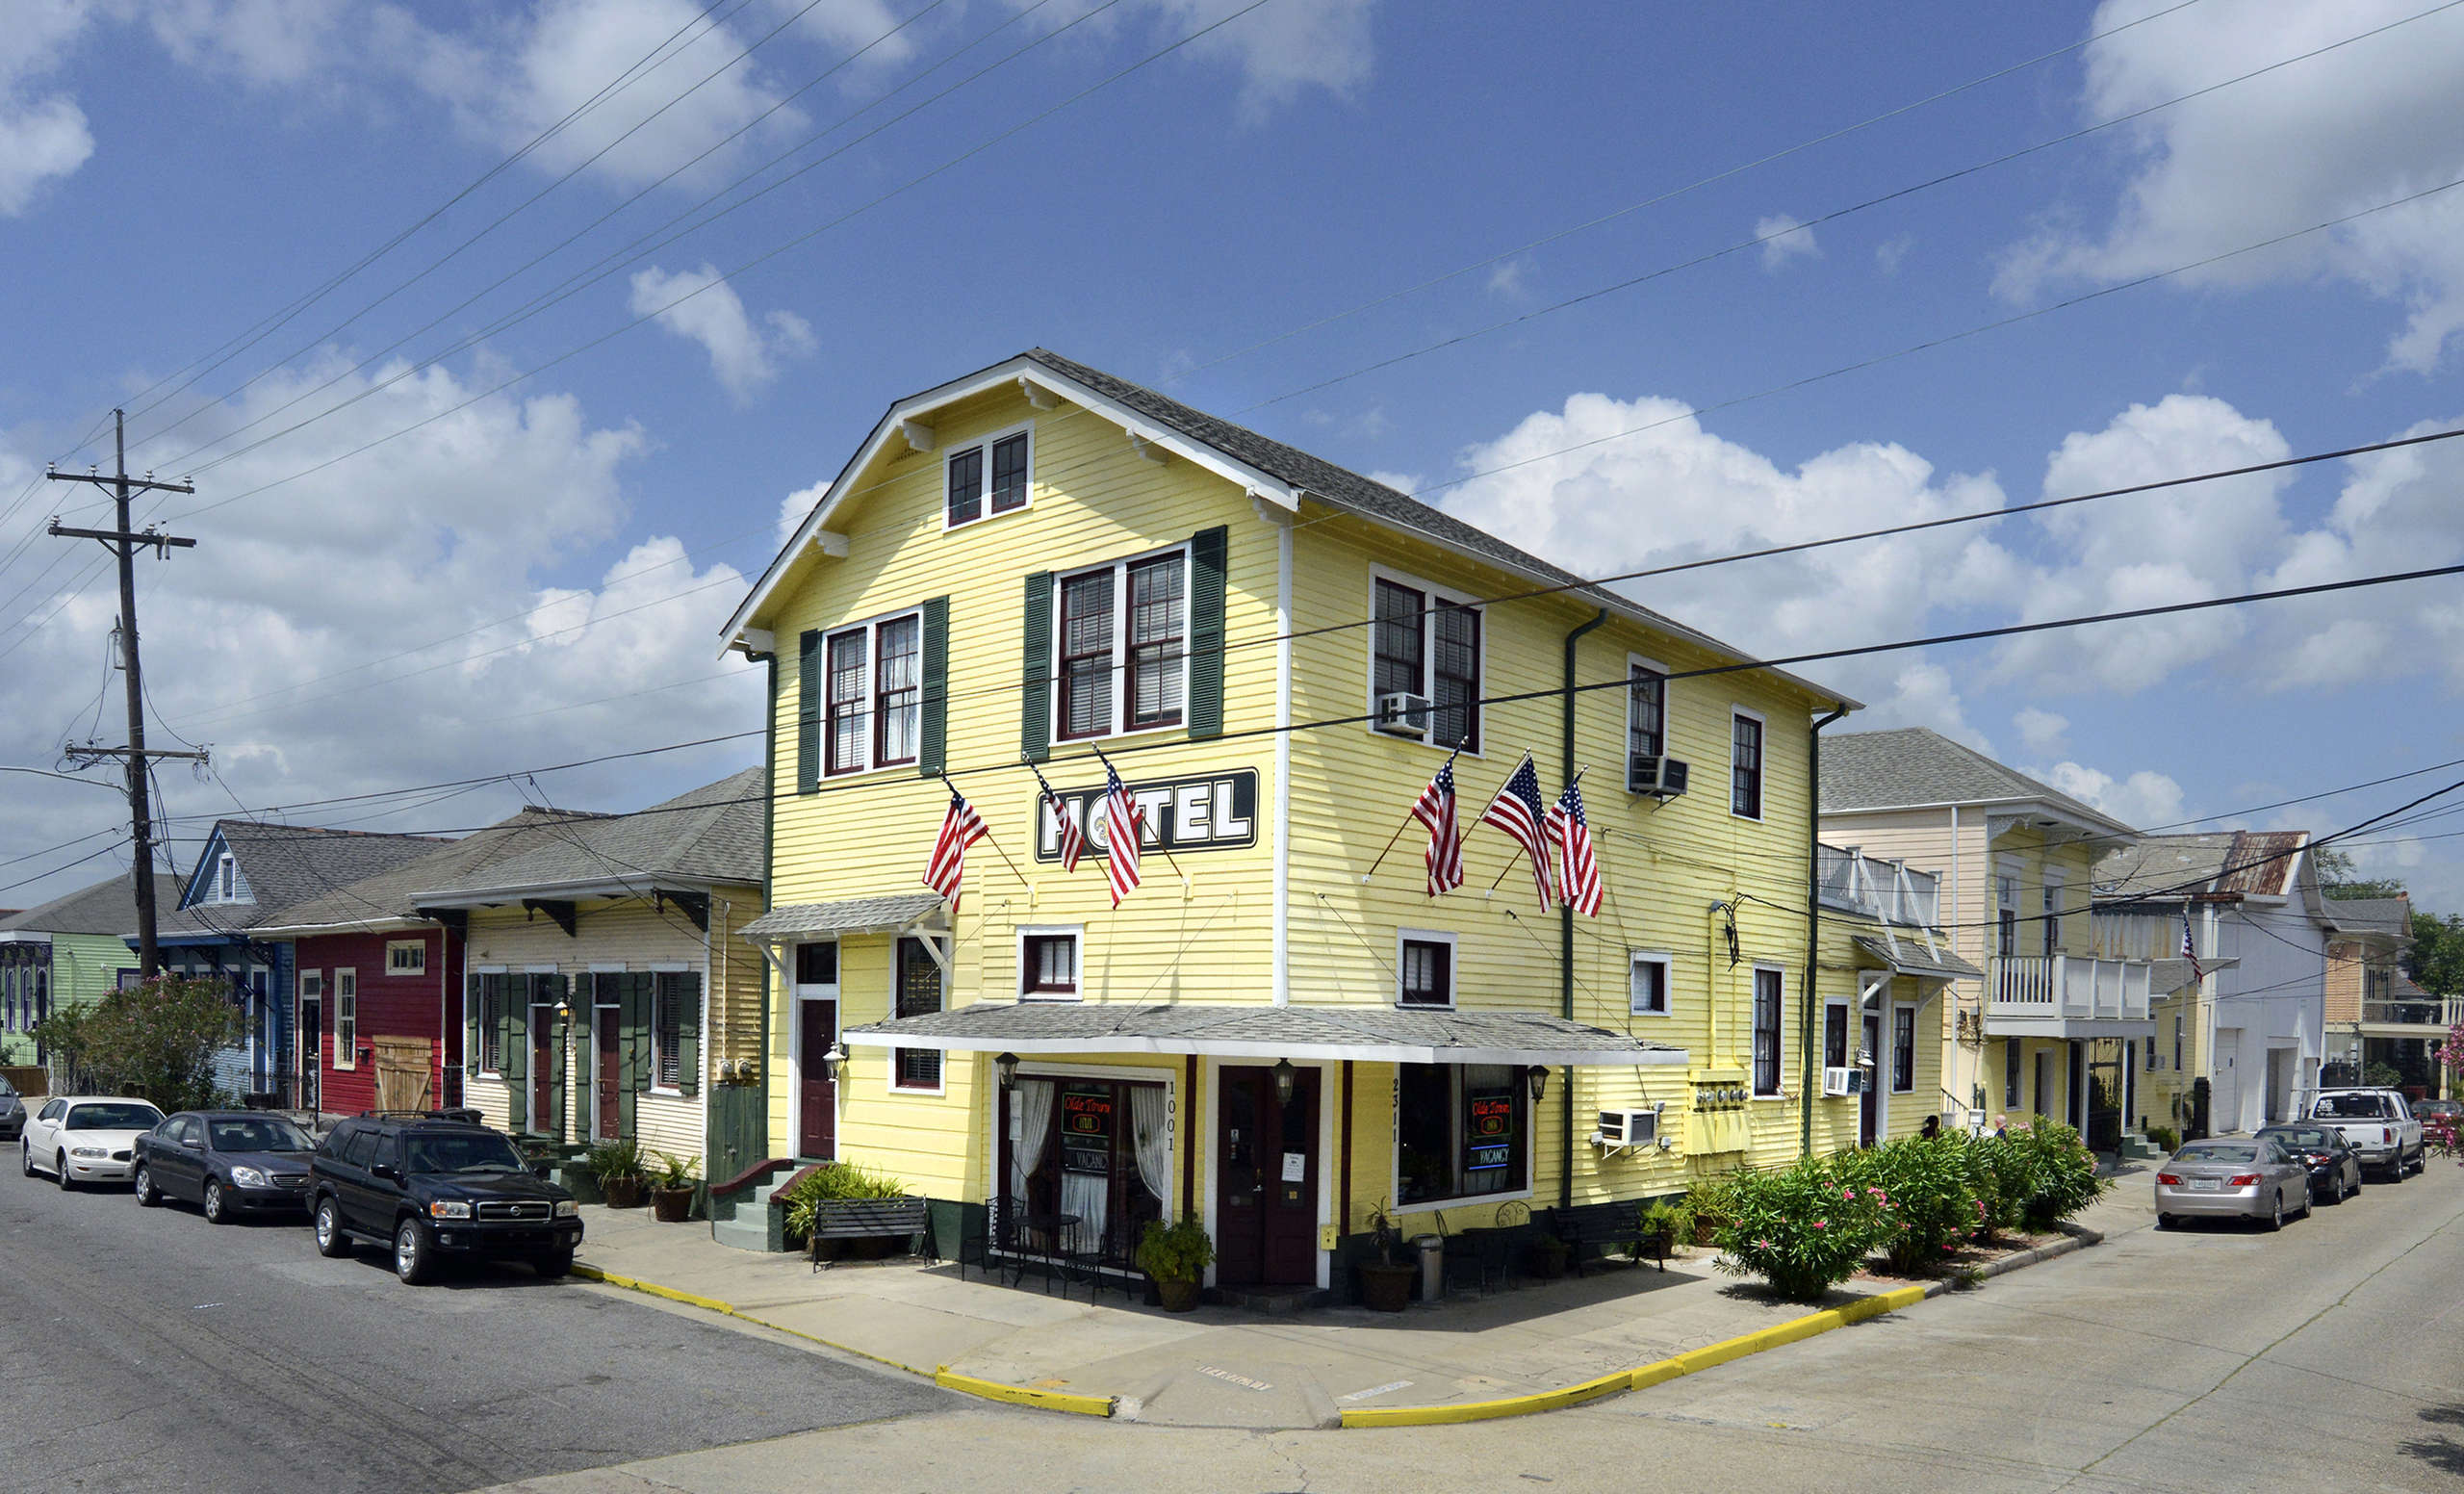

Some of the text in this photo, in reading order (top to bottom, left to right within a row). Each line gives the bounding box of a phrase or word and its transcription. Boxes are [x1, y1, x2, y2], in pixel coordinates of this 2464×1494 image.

[1065, 1096, 1110, 1114] Olde Town
[1473, 1101, 1488, 1116] Olde
[1168, 1081, 1176, 1150] 1001
[1480, 1147, 1509, 1164] VACANCY
